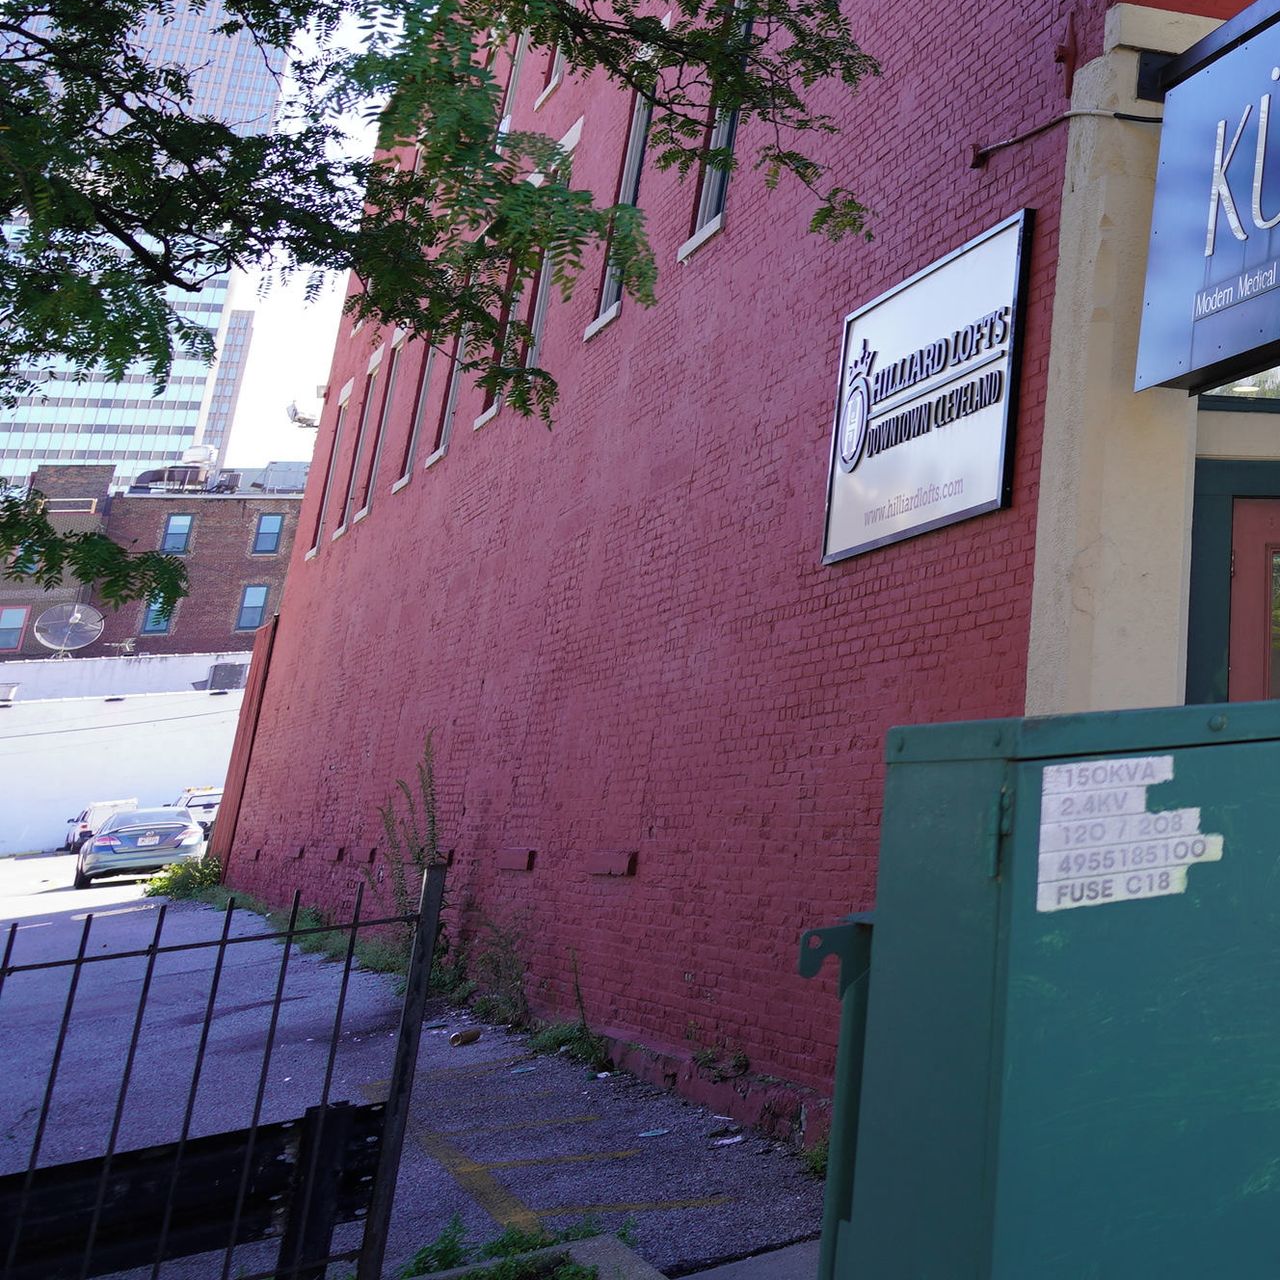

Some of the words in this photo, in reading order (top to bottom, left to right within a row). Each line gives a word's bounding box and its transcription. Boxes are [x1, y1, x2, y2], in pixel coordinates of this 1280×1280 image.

[1195, 286, 1233, 317] Modern
[1238, 261, 1277, 300] Medical
[871, 337, 950, 406] HILLIARD
[949, 305, 1011, 367] LOFTS
[866, 400, 934, 458] DOWNTOWN
[933, 369, 1005, 429] CLEVELAND
[863, 477, 964, 527] www.hilliardlofts.com
[1064, 760, 1156, 788] 150KVA
[1060, 791, 1128, 816] 2.4KV
[1062, 822, 1106, 846] 120
[1139, 814, 1183, 835] 208
[1057, 838, 1207, 875] 4955185100
[1056, 878, 1114, 906] FUSE
[1125, 871, 1171, 895] C18
